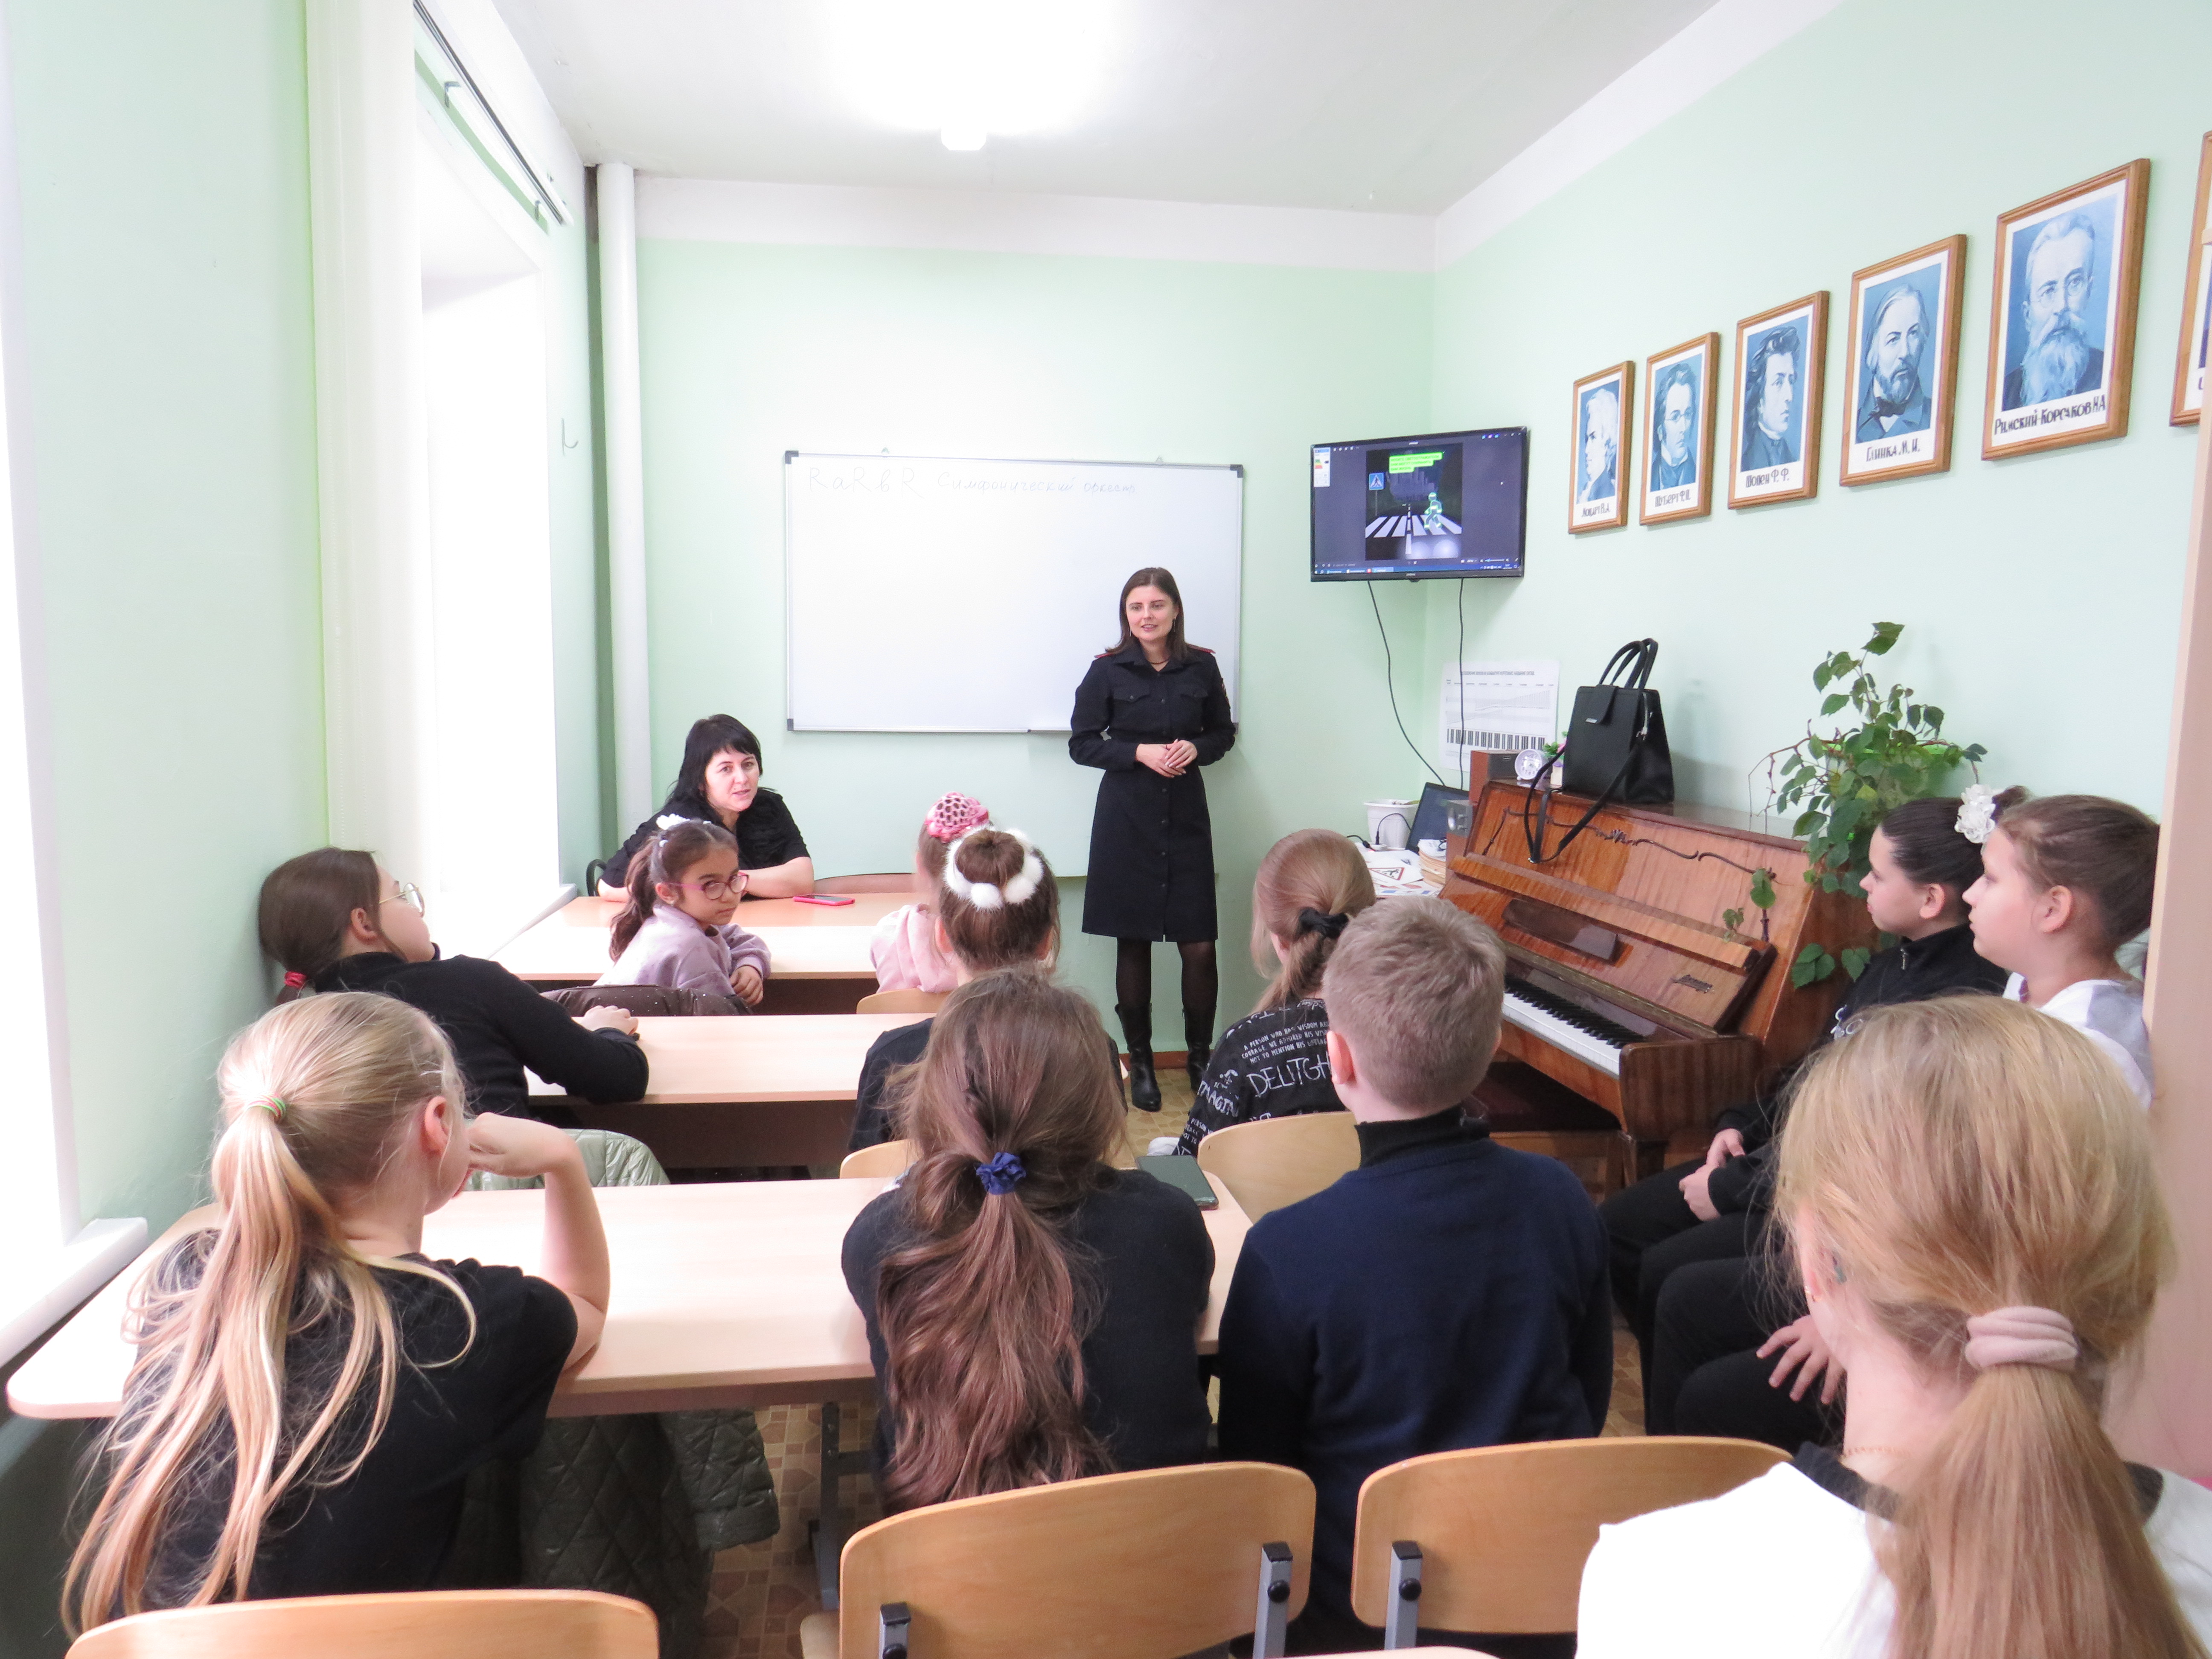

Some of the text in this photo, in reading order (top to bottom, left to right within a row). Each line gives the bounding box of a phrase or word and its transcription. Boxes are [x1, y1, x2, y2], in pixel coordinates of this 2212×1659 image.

[937, 471, 1136, 498] Симфонический оркестр
[1241, 1045, 1268, 1059] COURAGE
[1269, 1040, 1277, 1048] WE
[1304, 1029, 1314, 1038] HIS
[1249, 1034, 1269, 1048] PERSON
[1270, 1030, 1283, 1039] WHO
[1284, 1027, 1295, 1035] HAS
[1297, 1022, 1318, 1031] WISDOM
[1249, 1054, 1261, 1065] NOT
[1262, 1049, 1270, 1059] TO
[1270, 1042, 1295, 1057] MENTION
[1295, 1040, 1306, 1049] HIS
[1190, 1118, 1208, 1132] PERSON
